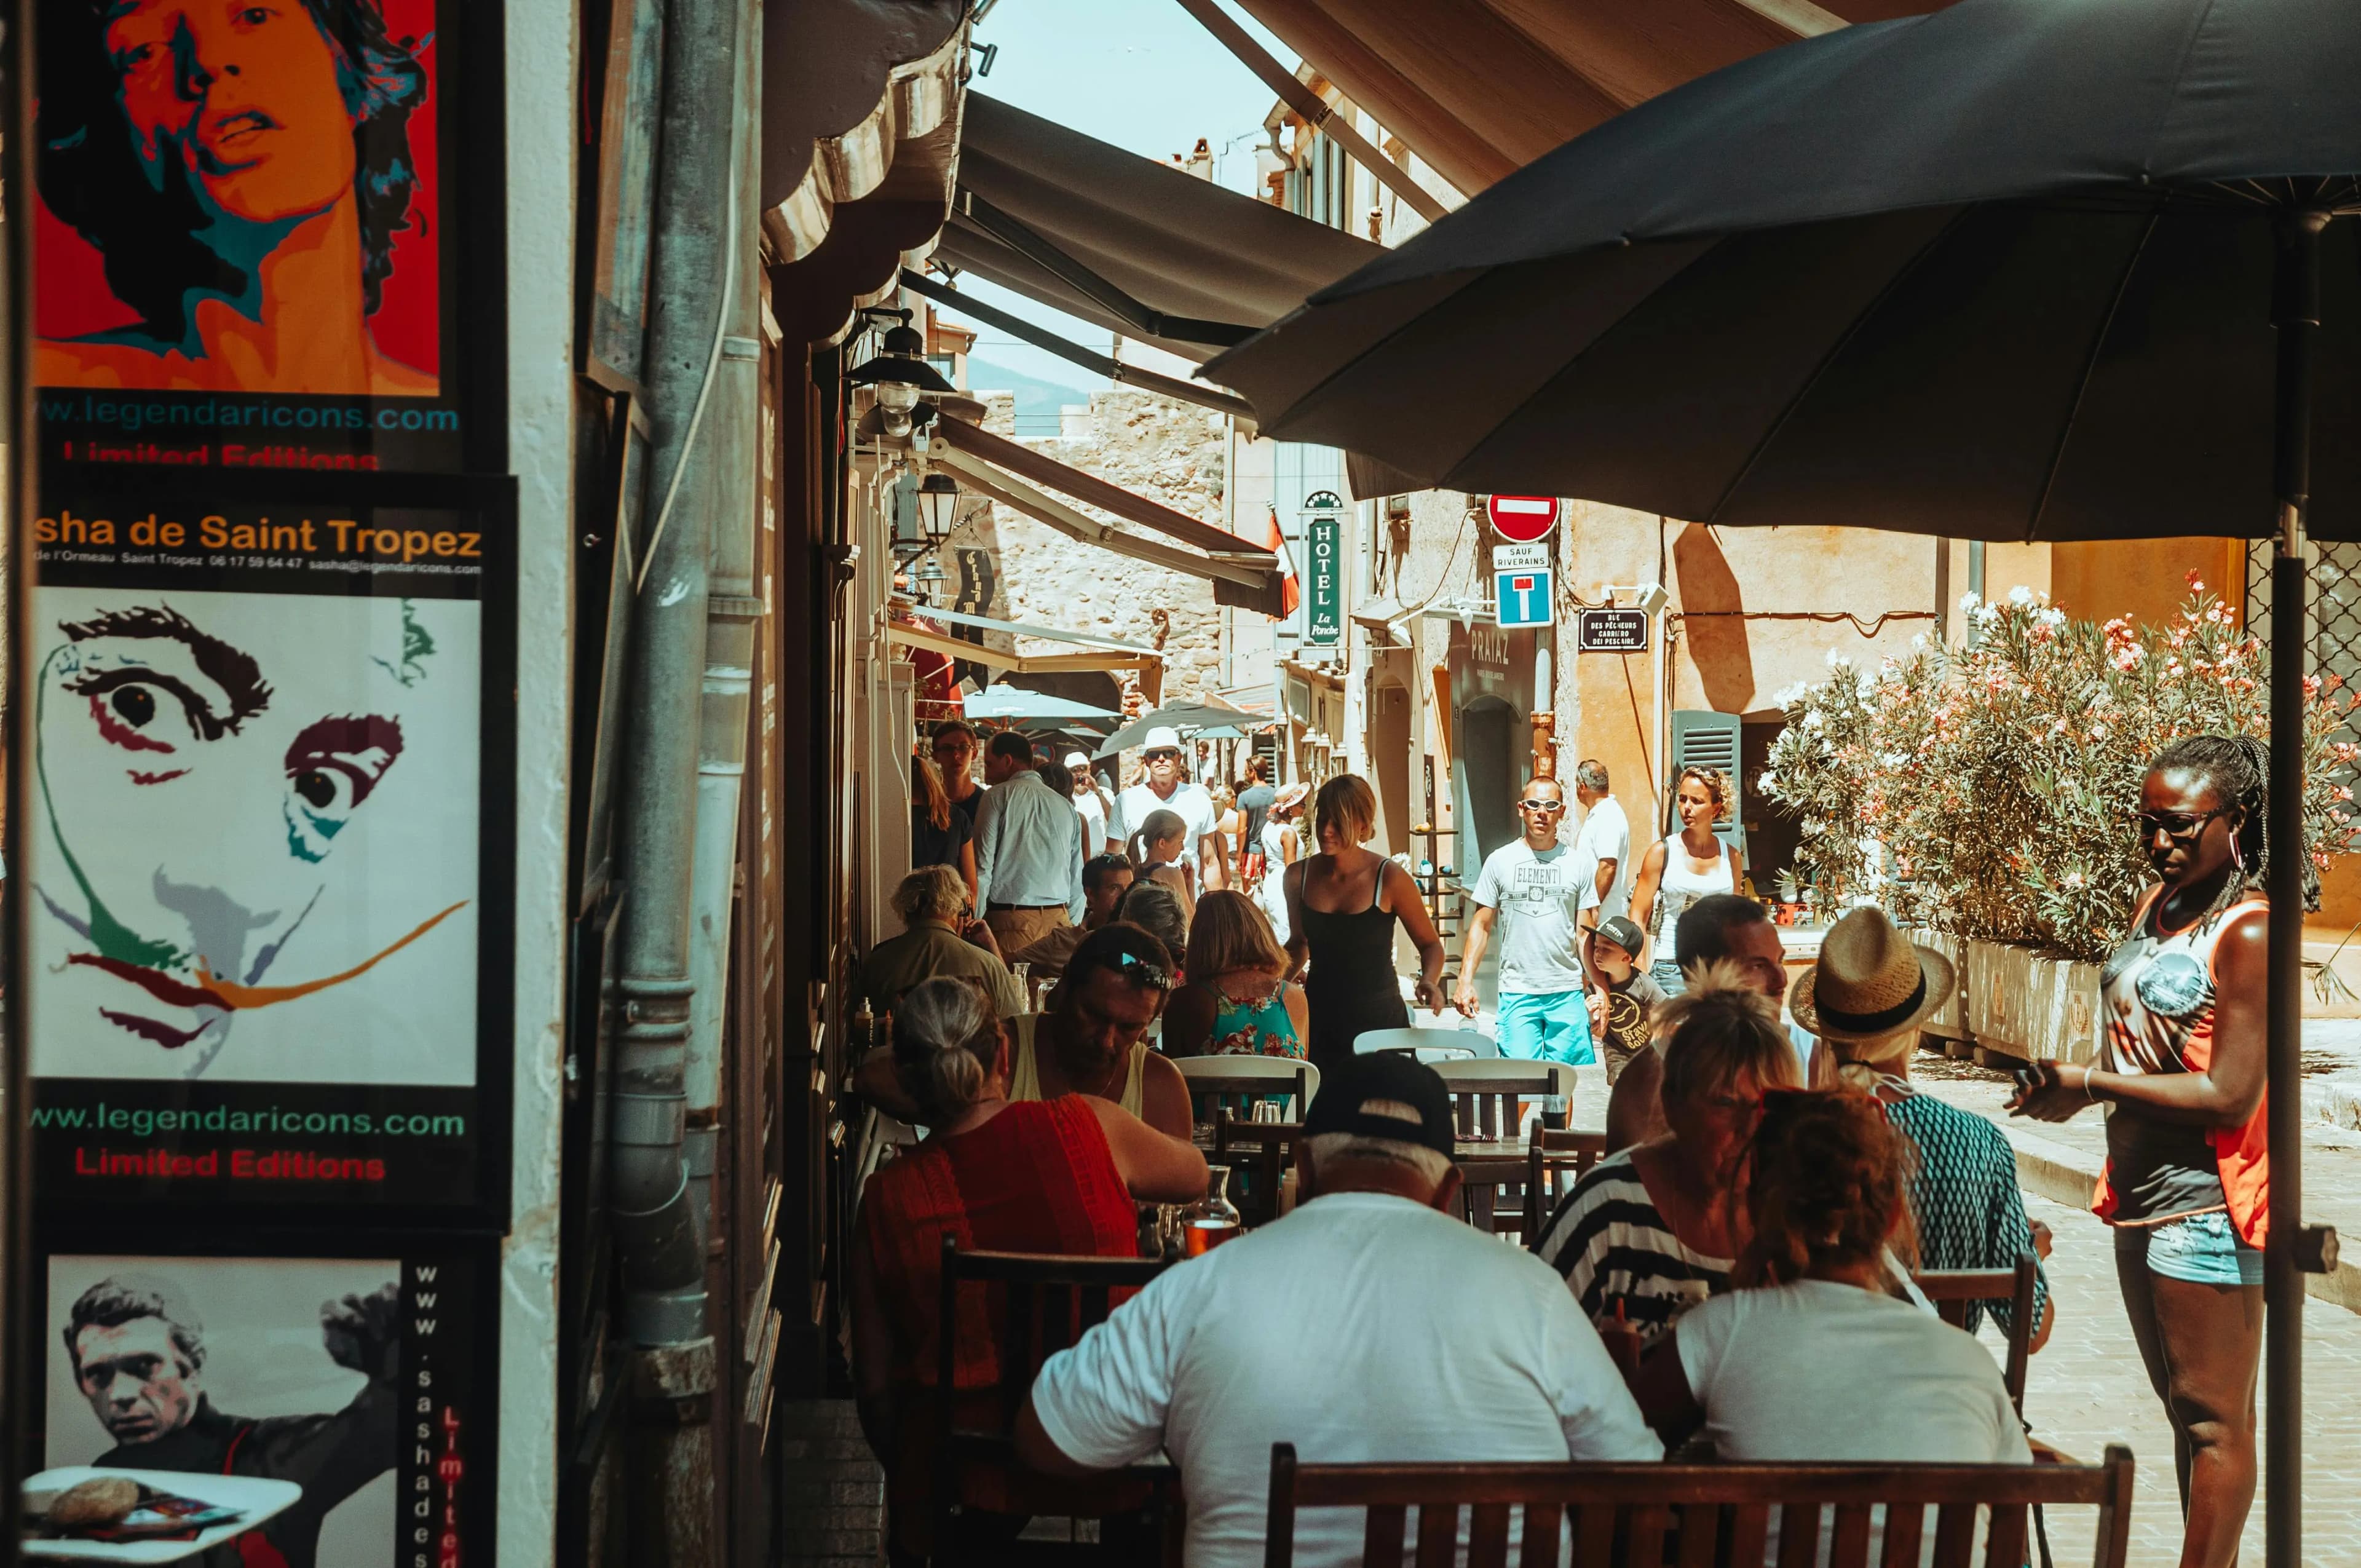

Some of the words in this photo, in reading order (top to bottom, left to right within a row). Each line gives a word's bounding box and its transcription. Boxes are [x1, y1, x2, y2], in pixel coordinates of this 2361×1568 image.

[34, 510, 116, 545] sha
[130, 513, 184, 547] de
[200, 515, 317, 552] Saint
[326, 520, 481, 563] Tropez
[121, 552, 155, 564] Saint
[159, 553, 204, 567] Tropez
[229, 556, 245, 567] 17
[1316, 526, 1331, 606] HOTEL
[1498, 557, 1545, 566] RIVERAINS
[1318, 613, 1331, 624] La
[1311, 625, 1339, 636] Ponche
[1517, 868, 1558, 884] ELEMENT
[76, 1147, 218, 1176] Limited
[231, 1149, 386, 1181] Editions
[441, 1405, 462, 1568] Limited
